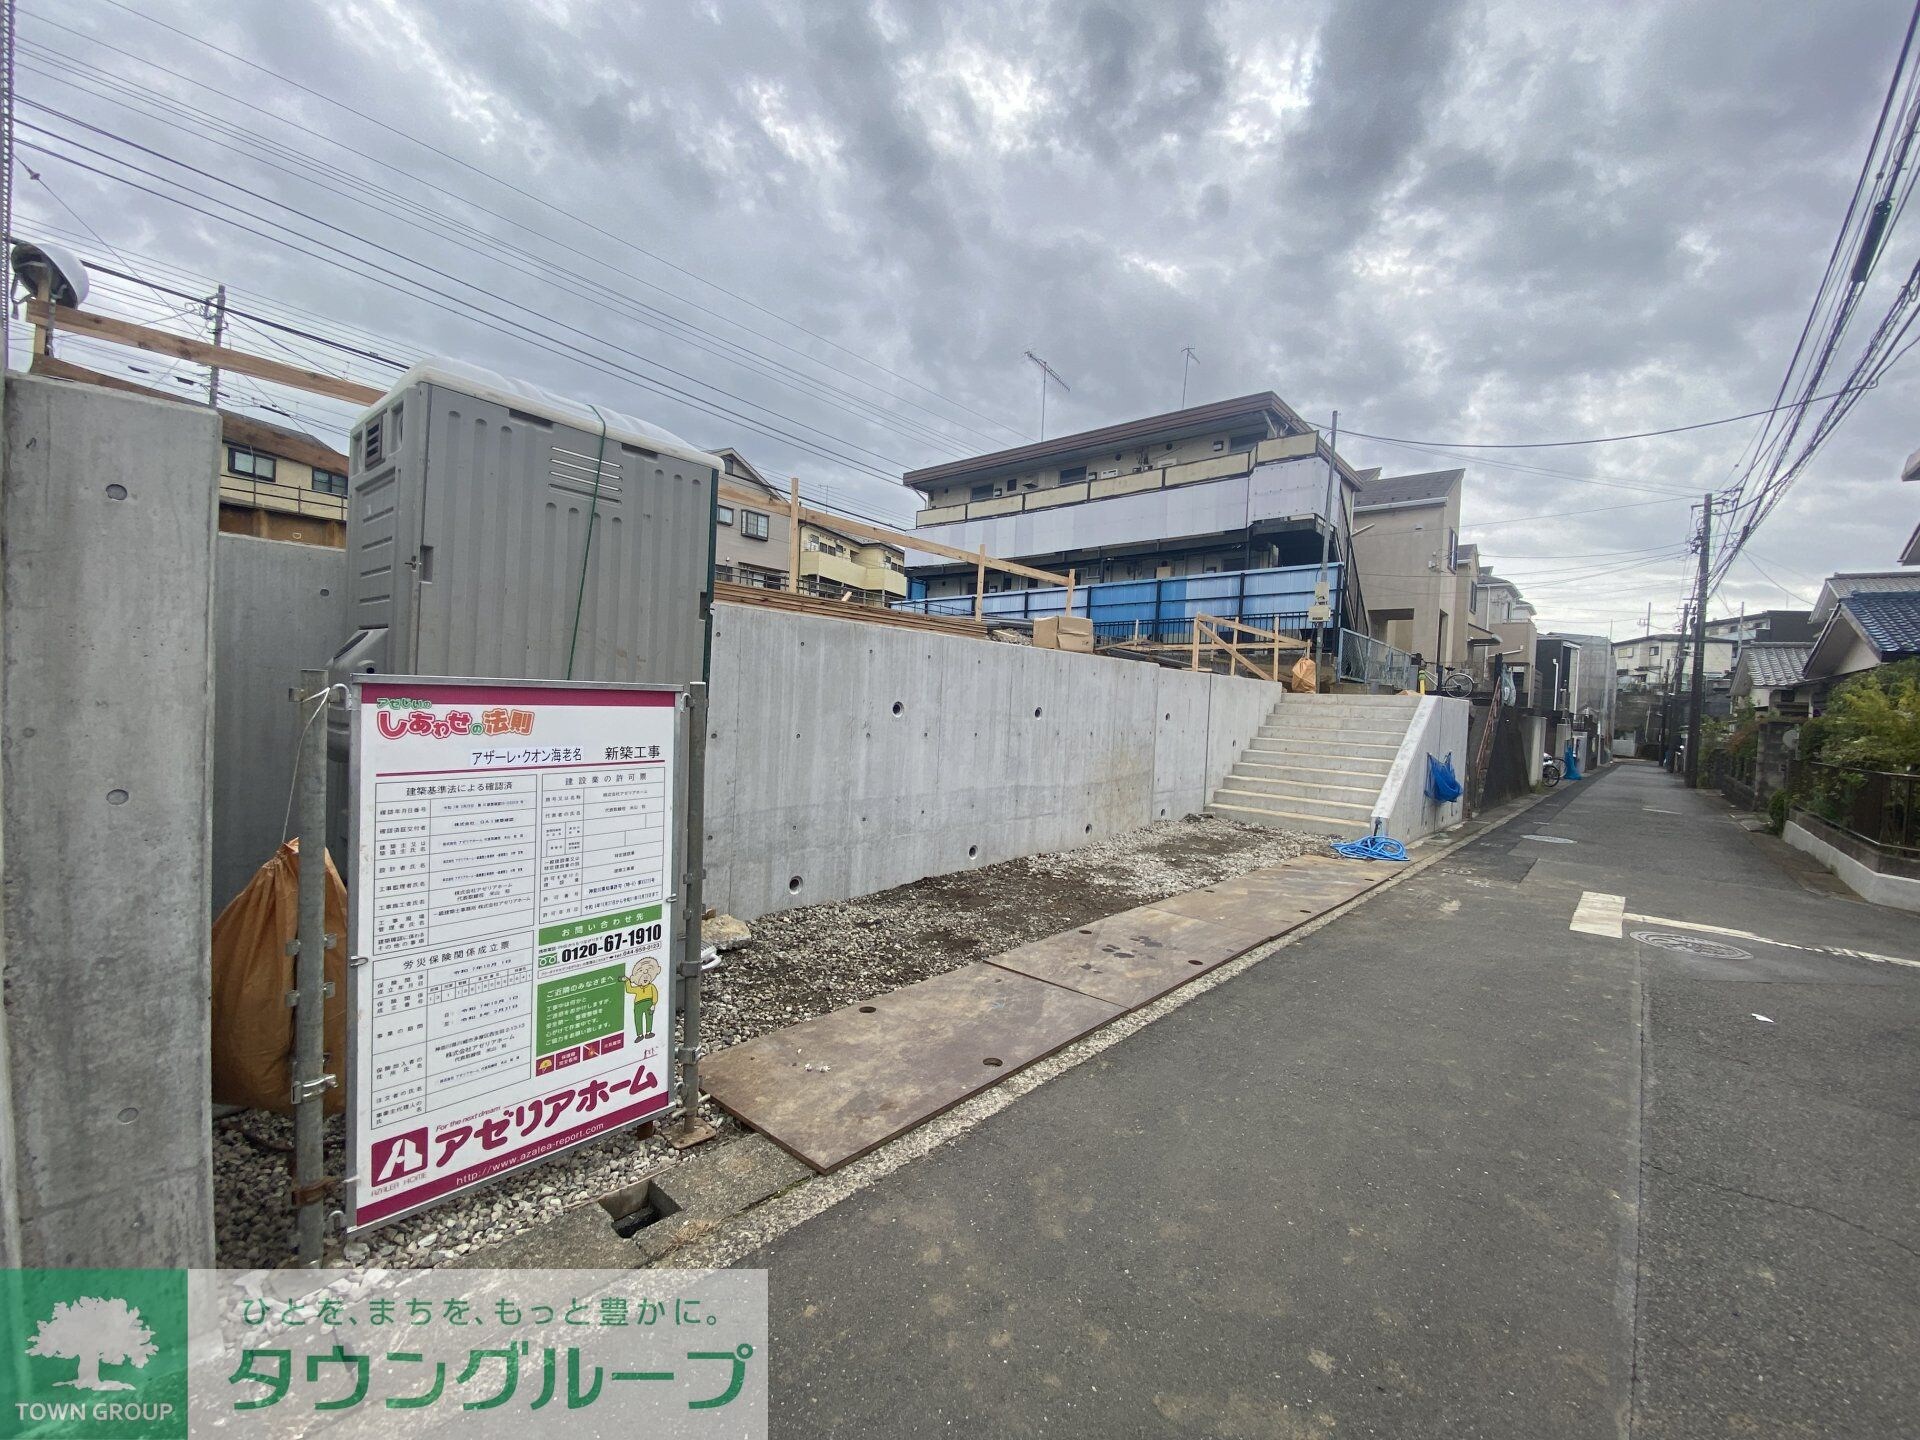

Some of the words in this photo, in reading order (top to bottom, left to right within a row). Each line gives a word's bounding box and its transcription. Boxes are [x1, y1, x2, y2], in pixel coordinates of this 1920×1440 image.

[378, 708, 535, 740] しあわせの法則
[472, 747, 582, 766] アザーレ・クオン海老名
[605, 745, 661, 761] 新築工事
[406, 781, 513, 797] 建築基準法による確認済
[565, 772, 647, 786] 建設業の許可票
[454, 883, 513, 896] 株式会社アゼリアホーム
[562, 913, 644, 937] お問い合わせ先
[562, 923, 662, 963] 0120-67-1910
[403, 940, 511, 970] 労災保険関係成立票
[546, 975, 614, 998] ご近隣のみなさまへ
[435, 1064, 658, 1168] アゼリアホーム
[436, 1122, 449, 1133] For
[449, 1118, 461, 1127] the
[462, 1112, 478, 1124] next
[456, 1122, 604, 1186] http://www.azalea-report.com
